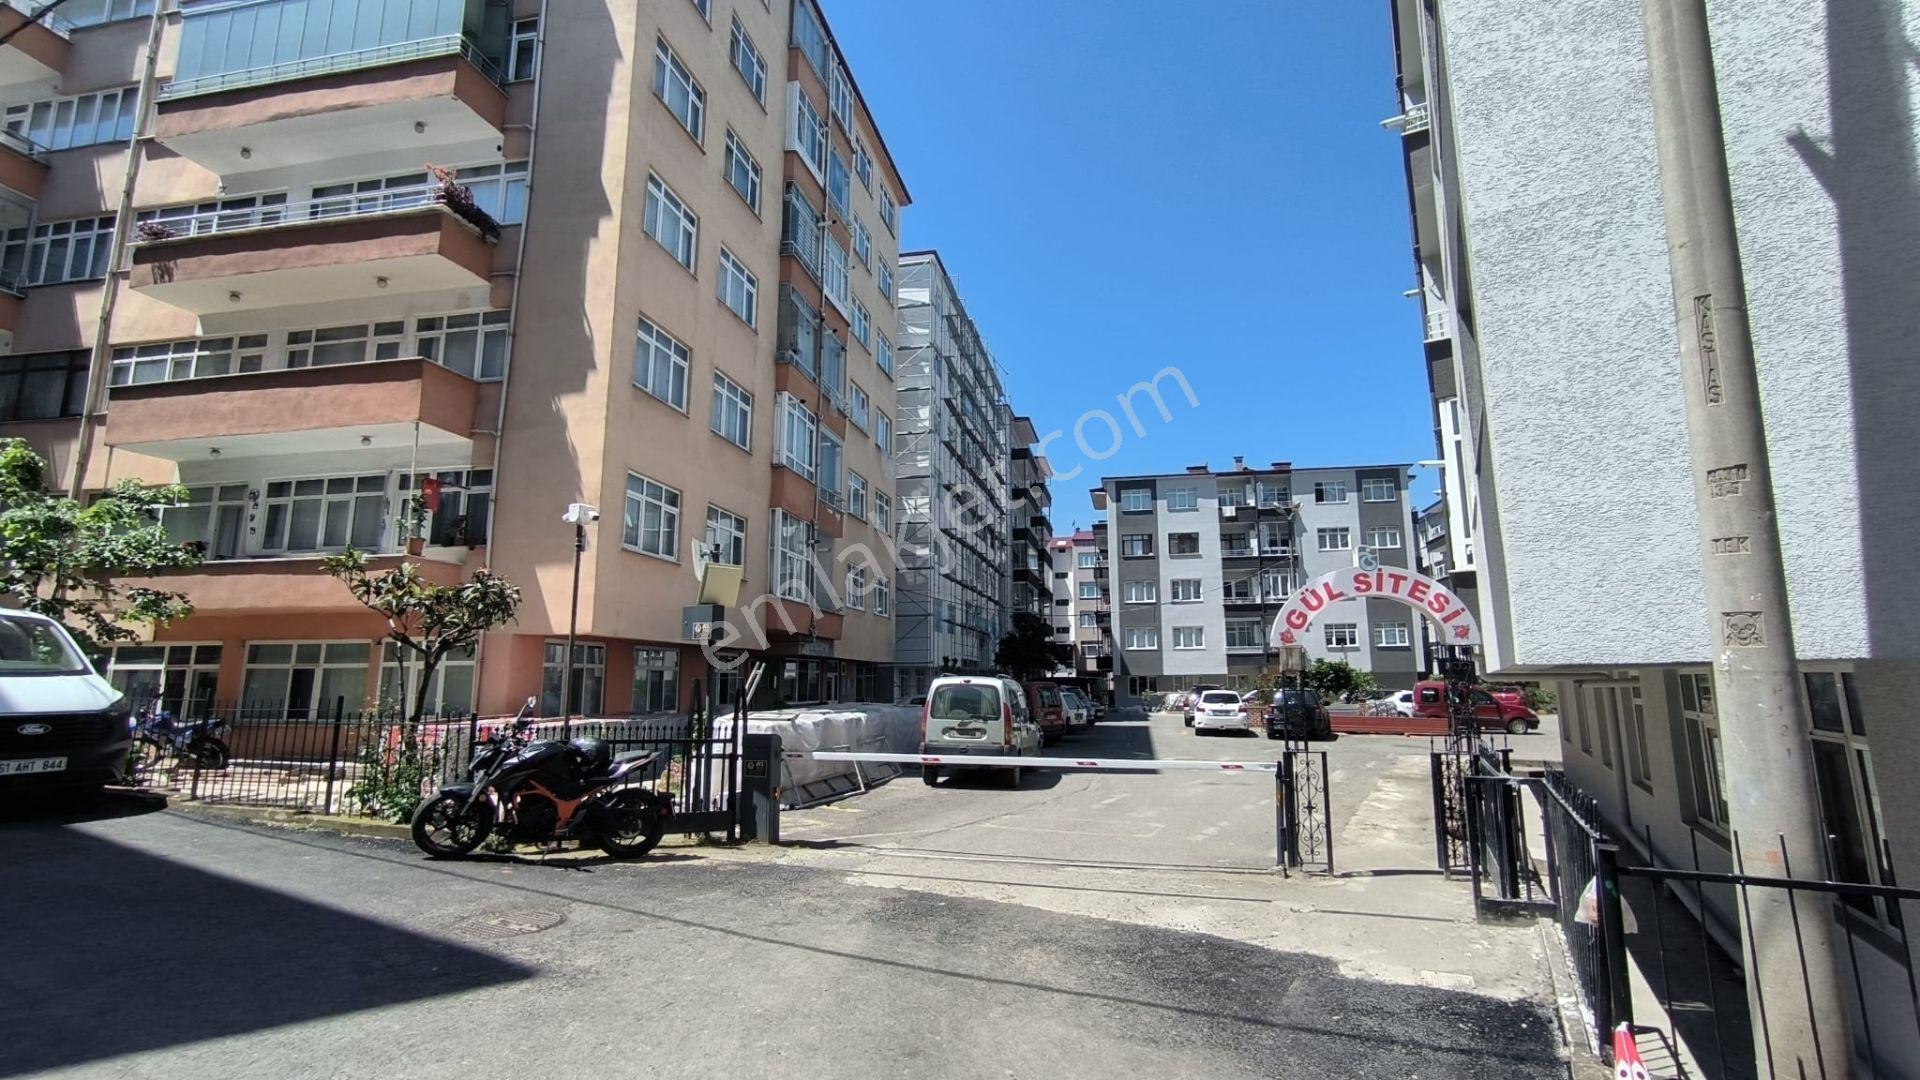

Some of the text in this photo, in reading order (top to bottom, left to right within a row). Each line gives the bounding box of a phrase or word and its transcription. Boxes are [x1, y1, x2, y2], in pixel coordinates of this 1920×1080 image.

[1286, 567, 1466, 629] GÜL SİTESİ
[15, 761, 35, 772] AHT
